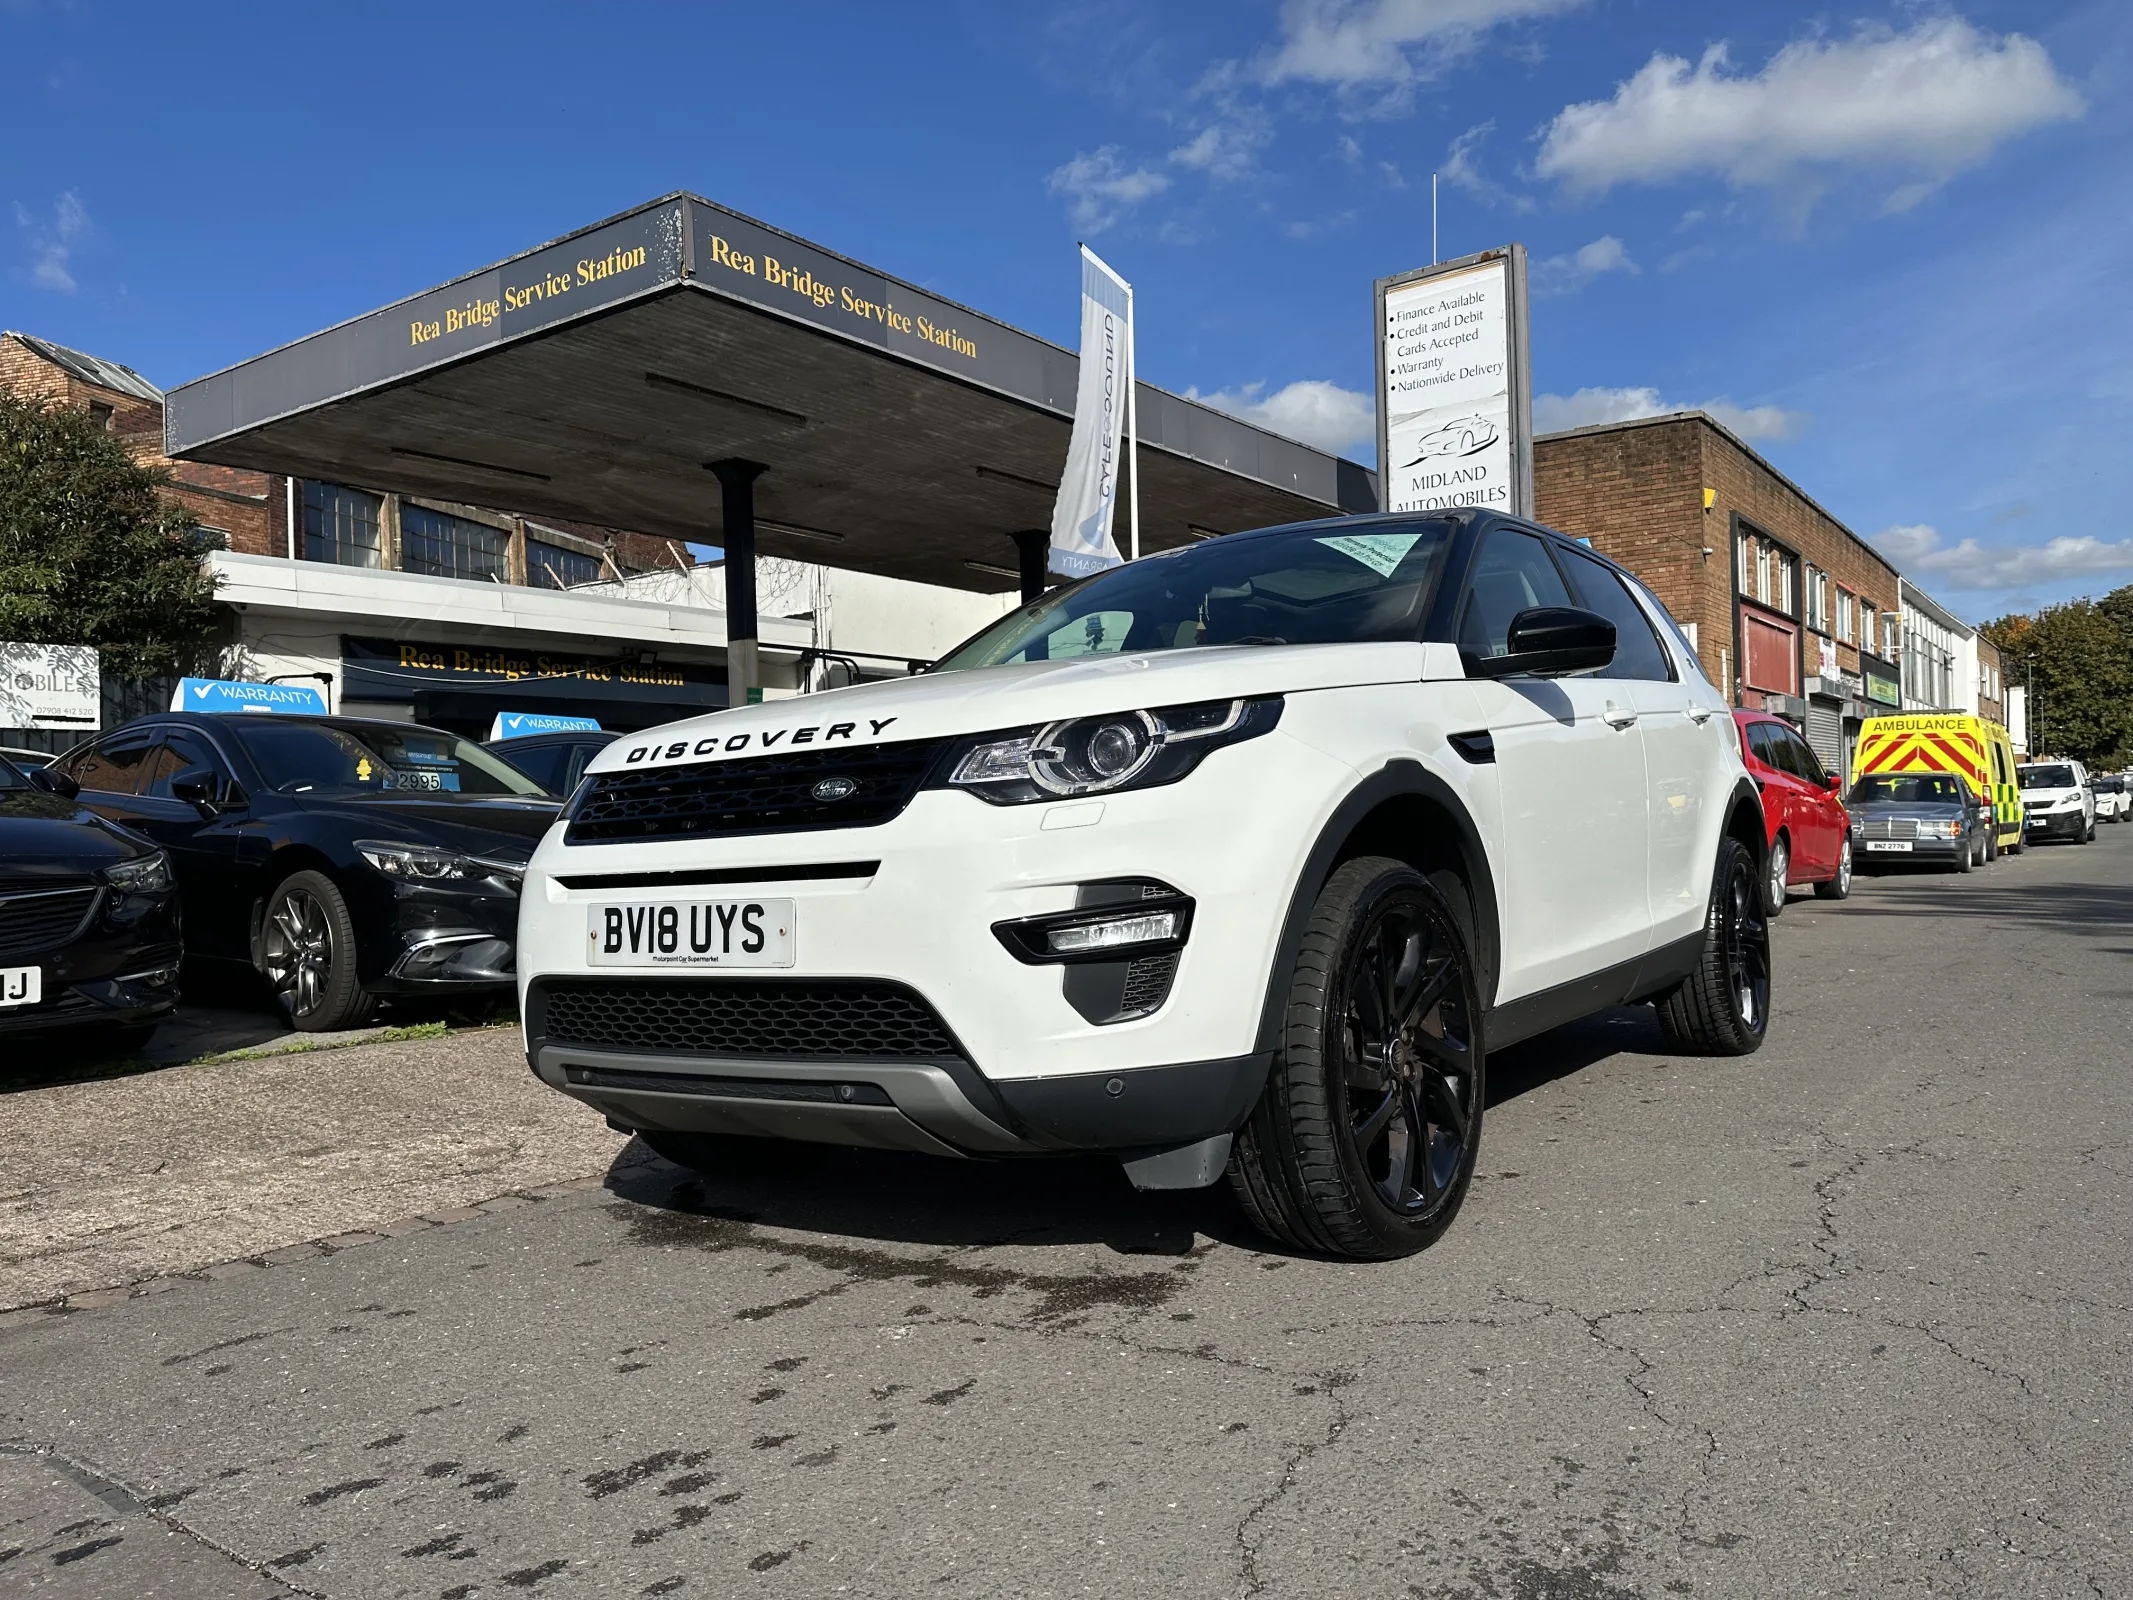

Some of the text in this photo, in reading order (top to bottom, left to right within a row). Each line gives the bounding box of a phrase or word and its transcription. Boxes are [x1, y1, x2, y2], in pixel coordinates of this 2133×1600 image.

[410, 246, 646, 346] Rea Bridge Service Station
[709, 234, 977, 358] Rea Bridge Service Station
[1397, 292, 1485, 322] Finance Available
[1397, 310, 1484, 339] Credit and Debit
[1397, 328, 1479, 357] Cards Accepted
[1398, 357, 1444, 375] Warranty
[1398, 362, 1504, 392] Nationwide Delivery
[1412, 465, 1487, 491] MIDLAND
[1396, 485, 1507, 511] AUTOMOBILES
[399, 645, 684, 686] Rea Bridge Service Station
[218, 685, 312, 704] WARRANTY
[36, 706, 62, 714] 07908
[64, 707, 77, 715] 412
[525, 718, 593, 731] WARRANTY
[1873, 719, 1967, 732] AMBULANCE
[626, 717, 898, 764] DISCOVERY
[603, 904, 765, 953] BV18 UYS
